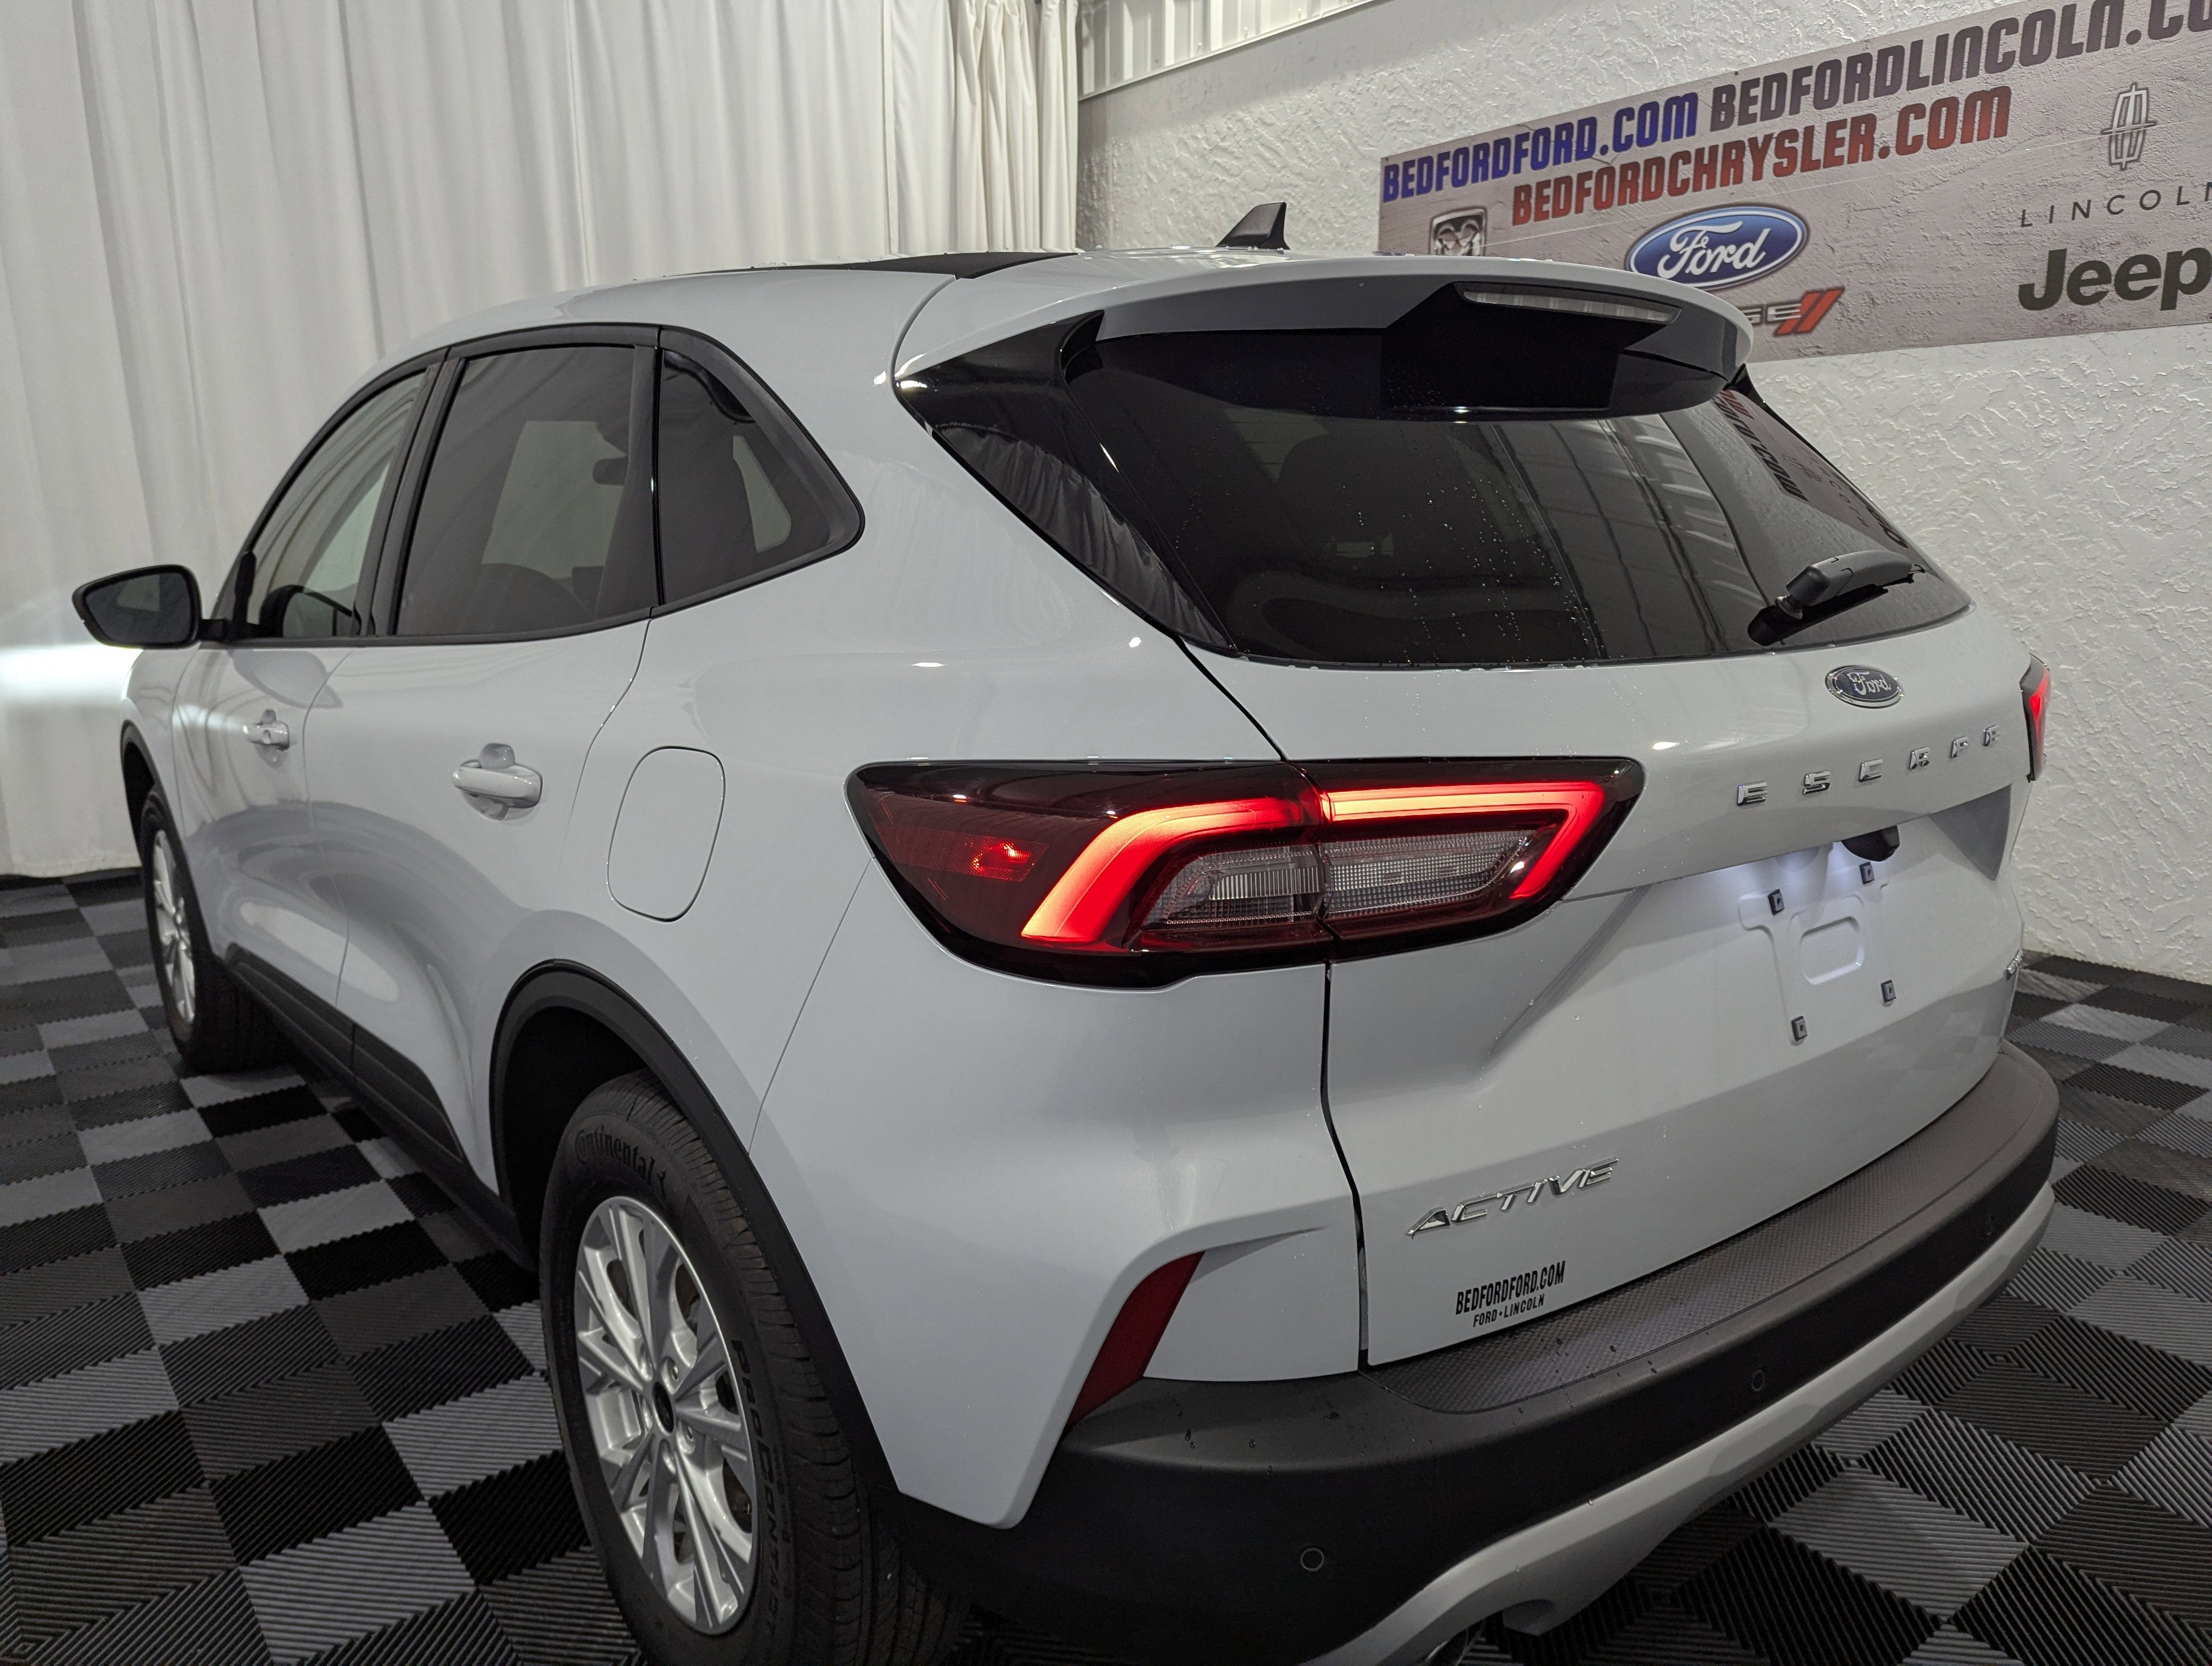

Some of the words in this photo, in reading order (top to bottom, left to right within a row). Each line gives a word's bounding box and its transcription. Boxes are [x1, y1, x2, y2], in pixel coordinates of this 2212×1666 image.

[1382, 91, 1699, 202] BEDFORDFORD.COM
[1512, 85, 2010, 226] BEDFORDCHRYSLER.COM
[1657, 221, 1771, 279] Ford
[2018, 247, 2212, 311] Jeep
[1850, 671, 1892, 695] Ford
[1737, 725, 1999, 806] ESCAPE
[574, 1123, 656, 1187] Continental
[1405, 1157, 1619, 1239] ACTIVE
[1456, 1260, 1566, 1316] BEDFORDFORD.COM
[1473, 1309, 1497, 1327] FORD
[1504, 1294, 1545, 1318] LINCOLN
